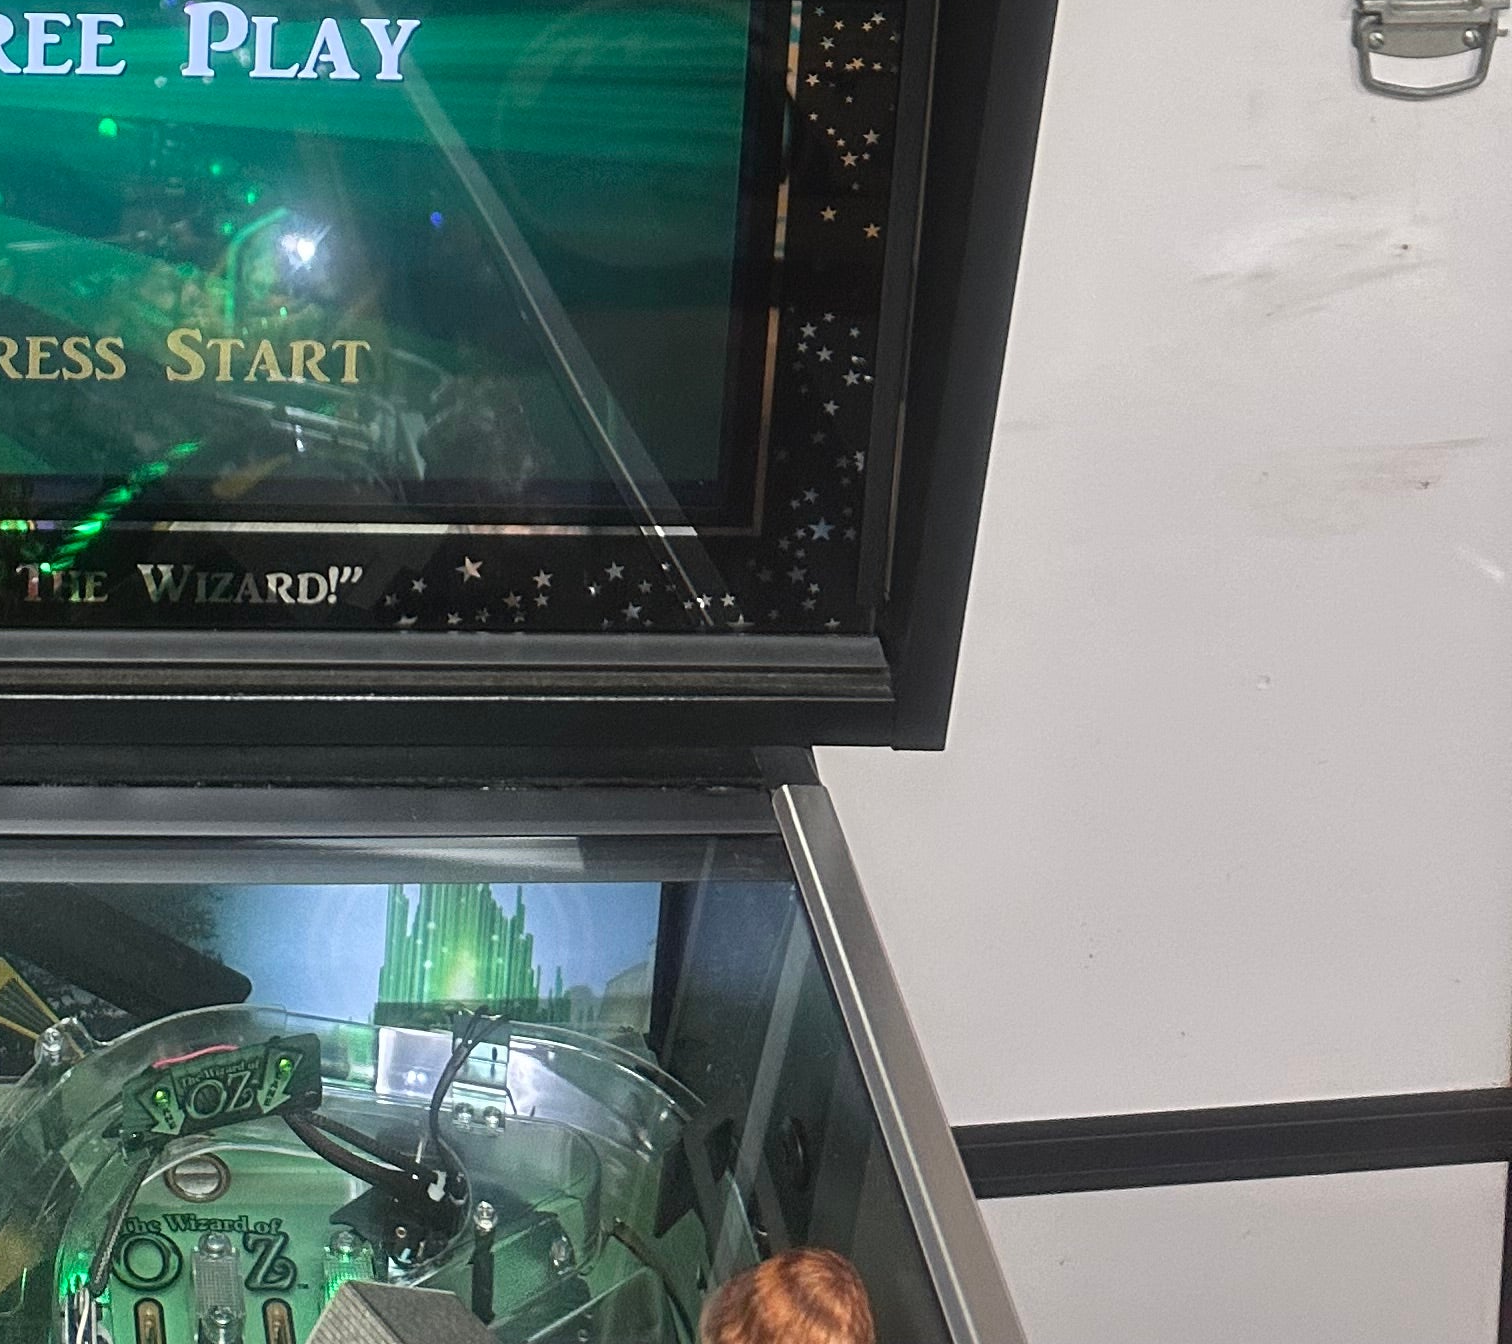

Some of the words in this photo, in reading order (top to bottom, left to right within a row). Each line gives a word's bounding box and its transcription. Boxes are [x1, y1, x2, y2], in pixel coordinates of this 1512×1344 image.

[180, 1073, 201, 1089] The
[201, 1061, 245, 1081] Wizard
[246, 1059, 260, 1071] of
[185, 1070, 255, 1120] OZ
[121, 1215, 161, 1234] The
[162, 1213, 249, 1233] Wizard
[253, 1218, 284, 1235] of
